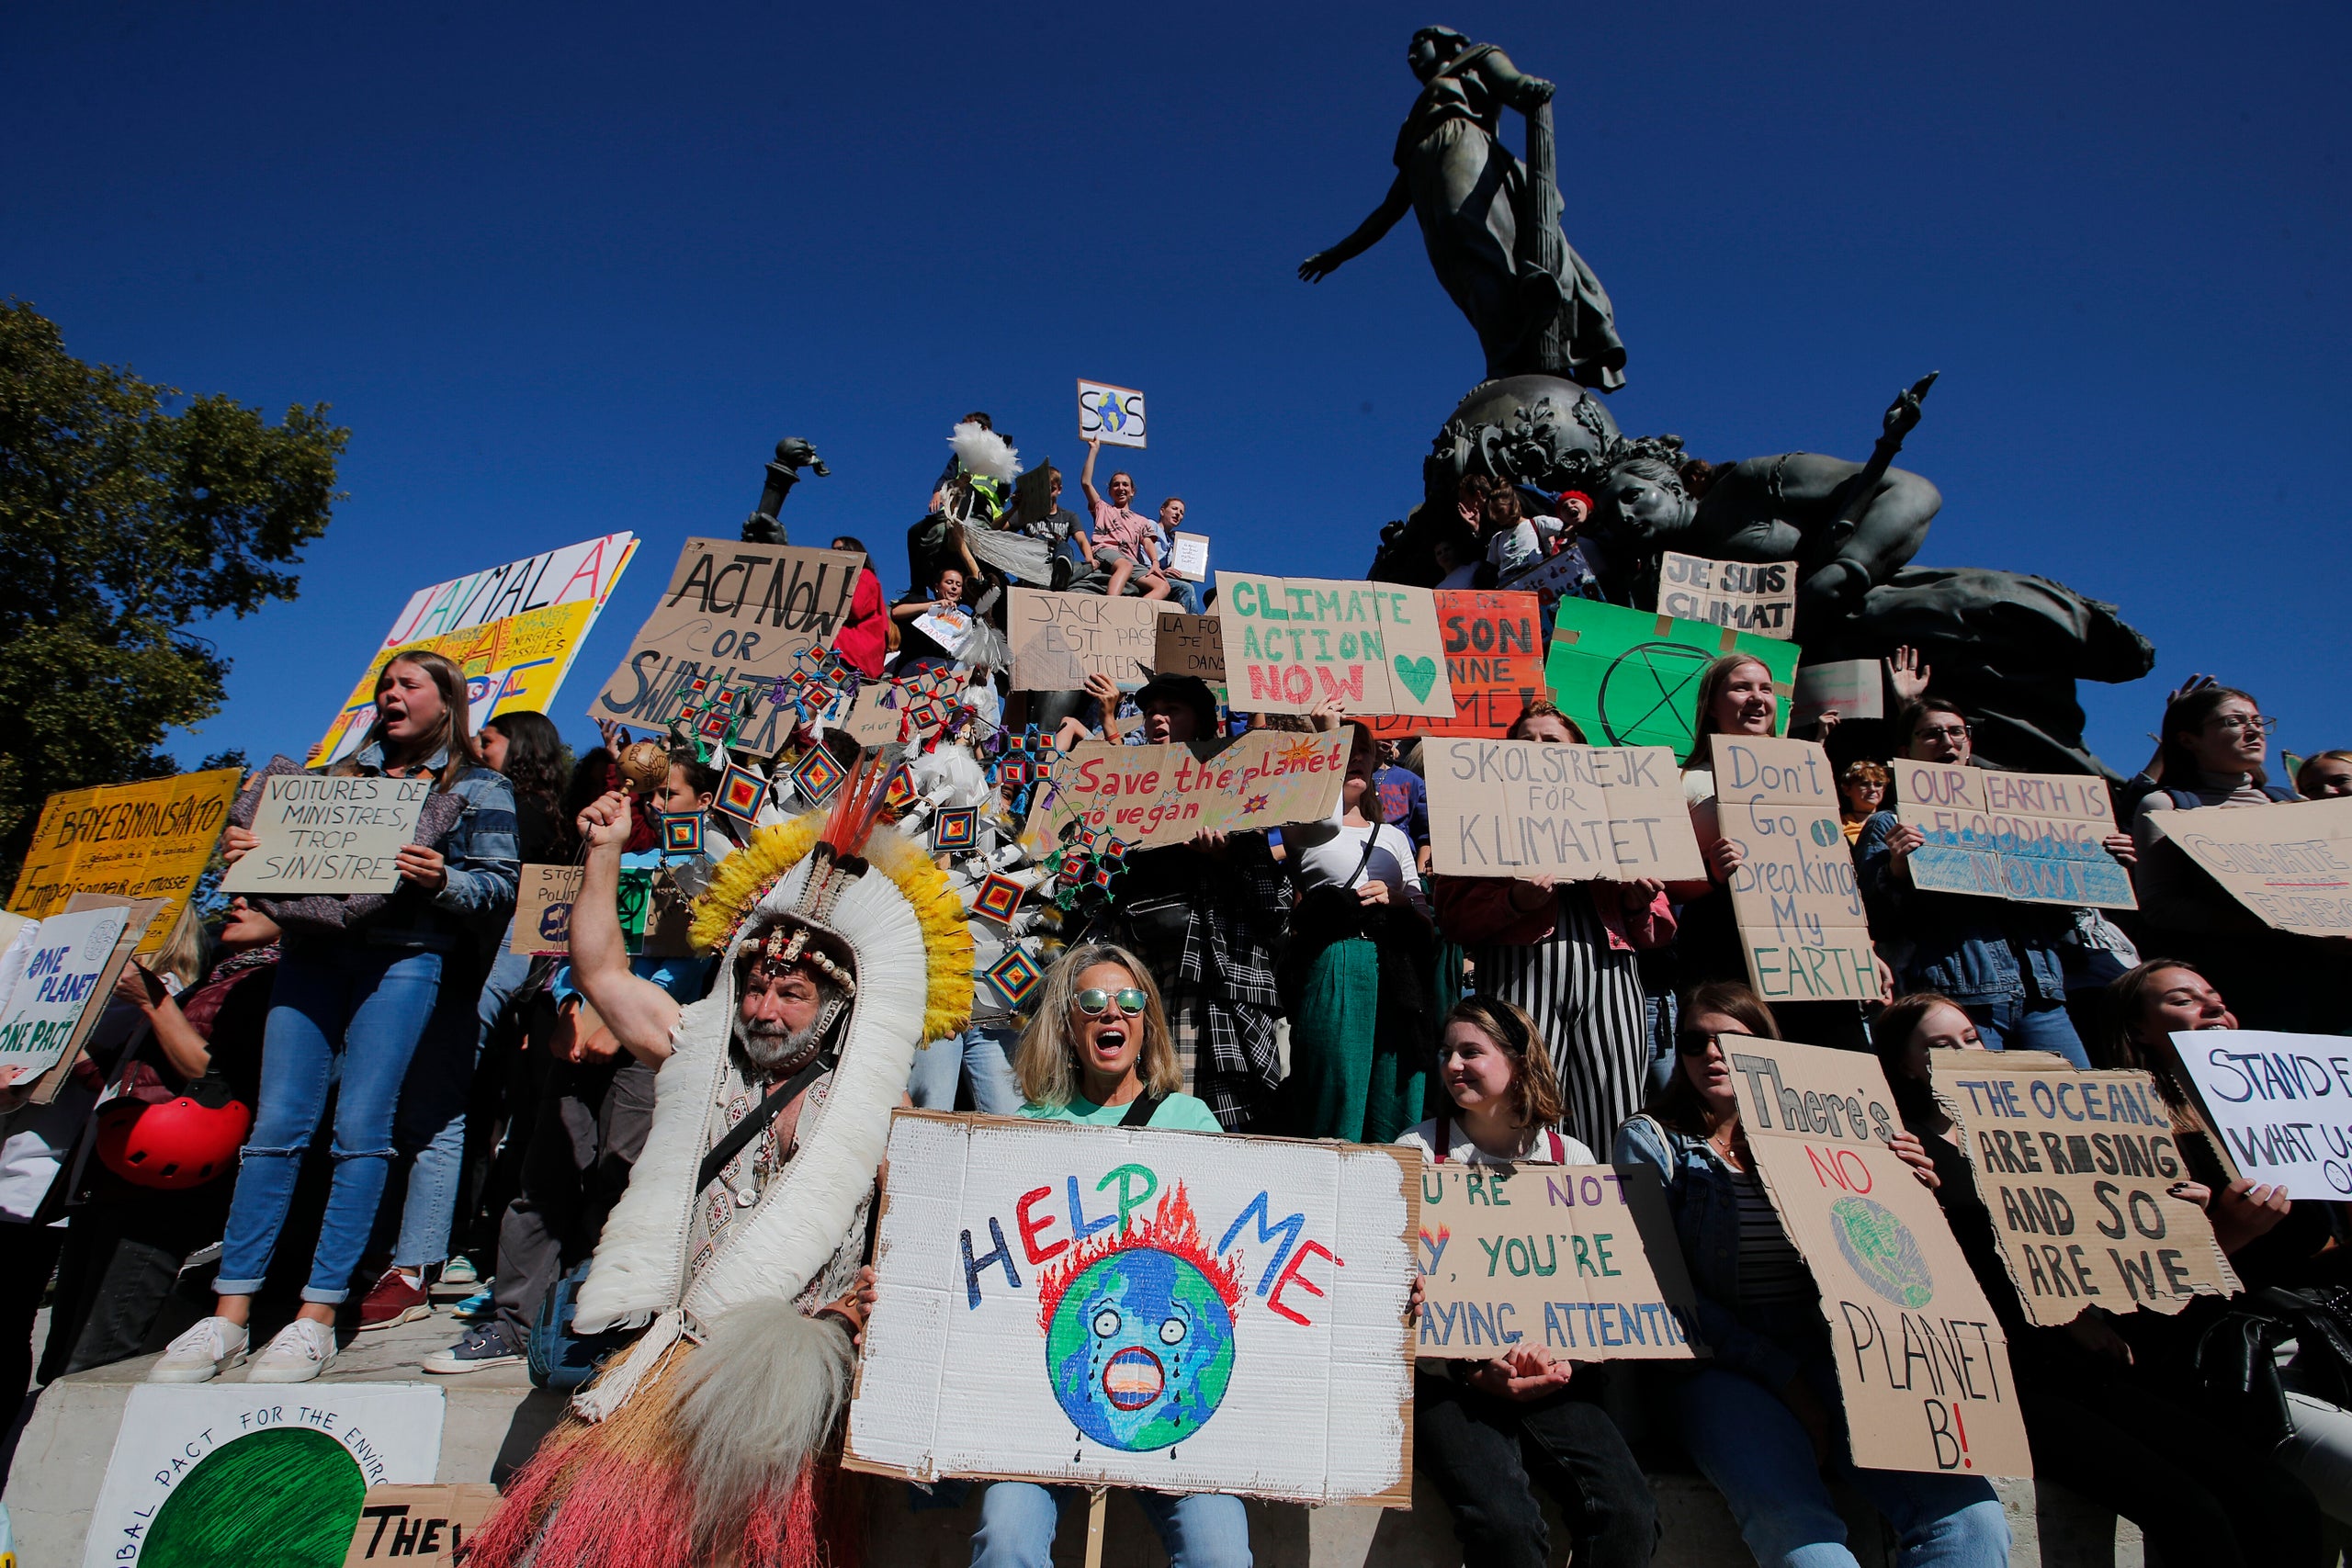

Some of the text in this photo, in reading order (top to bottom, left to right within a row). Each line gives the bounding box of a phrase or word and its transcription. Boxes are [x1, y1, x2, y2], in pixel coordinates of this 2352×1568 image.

[666, 553, 857, 637] ACT NOW
[1666, 554, 1787, 594] JE SUIS
[1028, 594, 1112, 626] JACK
[1162, 616, 1184, 634] LA
[1231, 581, 1412, 626] CLIMATE
[1666, 592, 1792, 629] CLIMAT
[712, 629, 761, 661] OR
[1045, 625, 1103, 653] EST
[1177, 635, 1202, 648] JE
[1243, 625, 1385, 661] ACTION
[1445, 615, 1533, 654] SON
[1248, 663, 1364, 705] NOW
[1075, 742, 1343, 795] Save the planet
[1450, 741, 1659, 788] SKOLSTREJK
[1727, 745, 1824, 795] Don't
[272, 779, 427, 802] VOITURES DE
[1529, 784, 1587, 812] FÖR
[1911, 768, 2107, 818] OUR EARTH IS
[1116, 801, 1200, 834] vegan
[1749, 794, 1797, 837] Go
[1934, 810, 2096, 857] FLOODING
[288, 829, 357, 849] TROP
[1459, 814, 1661, 866] KLIMATET
[2183, 833, 2350, 874] CLIMATE
[542, 868, 584, 881] STOP
[1729, 838, 1861, 917] Breaking
[1969, 853, 2089, 904] NOW!
[1770, 895, 1825, 947] My
[28, 946, 71, 980] ONE
[1753, 946, 1881, 998] EARTH
[35, 973, 99, 1003] PLANET
[0, 1020, 74, 1054] ONE PACT
[2209, 1048, 2332, 1103] STAND
[1731, 1053, 1894, 1145] There's
[1956, 1080, 2027, 1118] THE
[1978, 1129, 2043, 1174] ARE
[2226, 1122, 2317, 1168] WHAT
[1545, 1173, 1634, 1208] NOT
[1804, 1144, 1874, 1195] NO
[1999, 1180, 2166, 1240] AND SO
[960, 1163, 1347, 1327] HELP ME
[1477, 1233, 1623, 1279] YOU'RE
[2021, 1243, 2194, 1301] ARE WE
[1839, 1300, 2001, 1404] PLANET
[154, 1427, 214, 1488] PACT
[240, 1405, 283, 1430] FOR
[299, 1405, 339, 1430] THE
[1924, 1397, 1973, 1470] B!
[362, 1504, 449, 1560] THE
